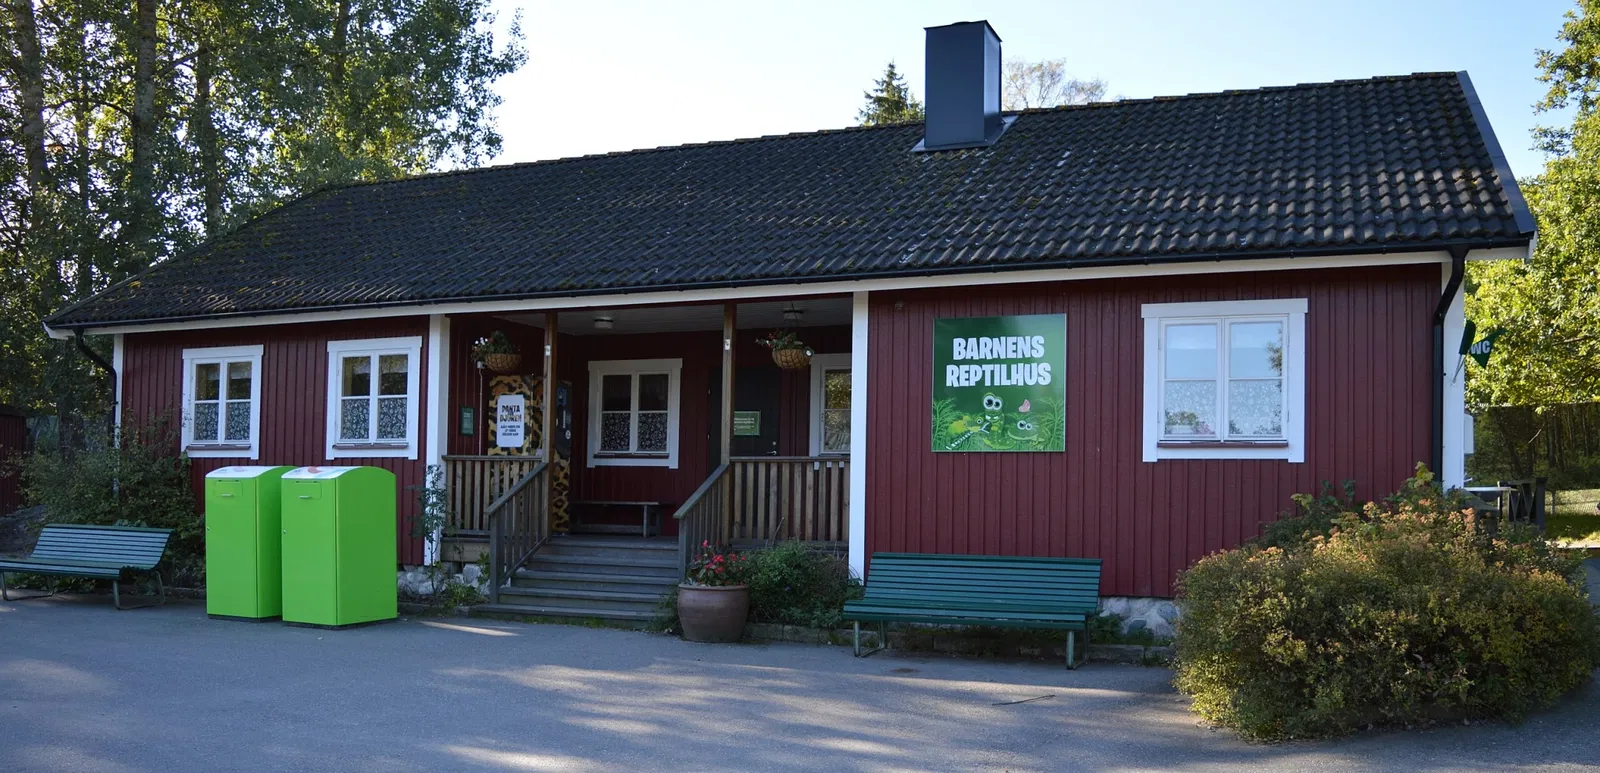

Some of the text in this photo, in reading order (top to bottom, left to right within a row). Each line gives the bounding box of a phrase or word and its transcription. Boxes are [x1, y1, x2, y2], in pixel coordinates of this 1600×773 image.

[953, 335, 1044, 360] BARNENS
[1470, 340, 1491, 355] WC
[946, 363, 1051, 387] REPTILHUS
